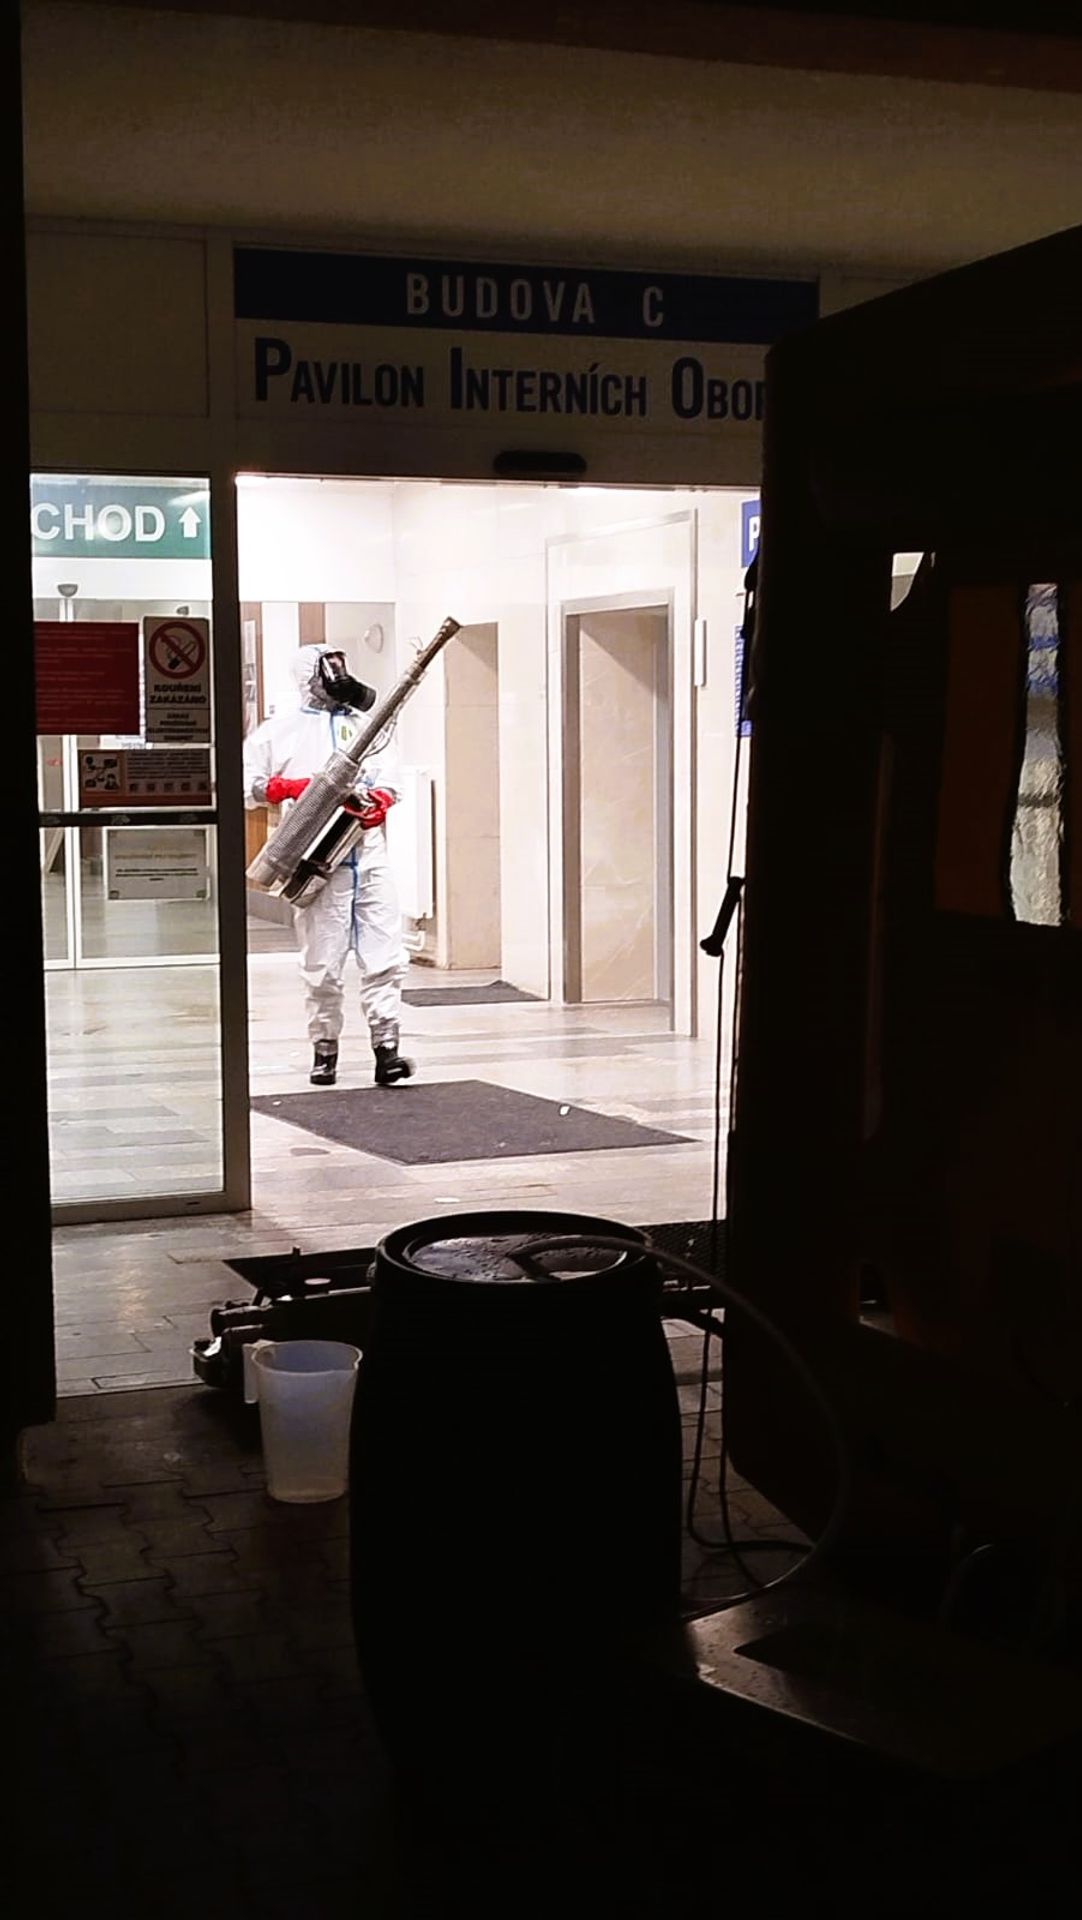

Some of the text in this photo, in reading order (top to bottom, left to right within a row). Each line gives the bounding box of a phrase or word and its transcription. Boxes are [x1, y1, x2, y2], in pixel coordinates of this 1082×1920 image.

[406, 273, 664, 328] BUDOVA C
[31, 502, 166, 542] CHOD
